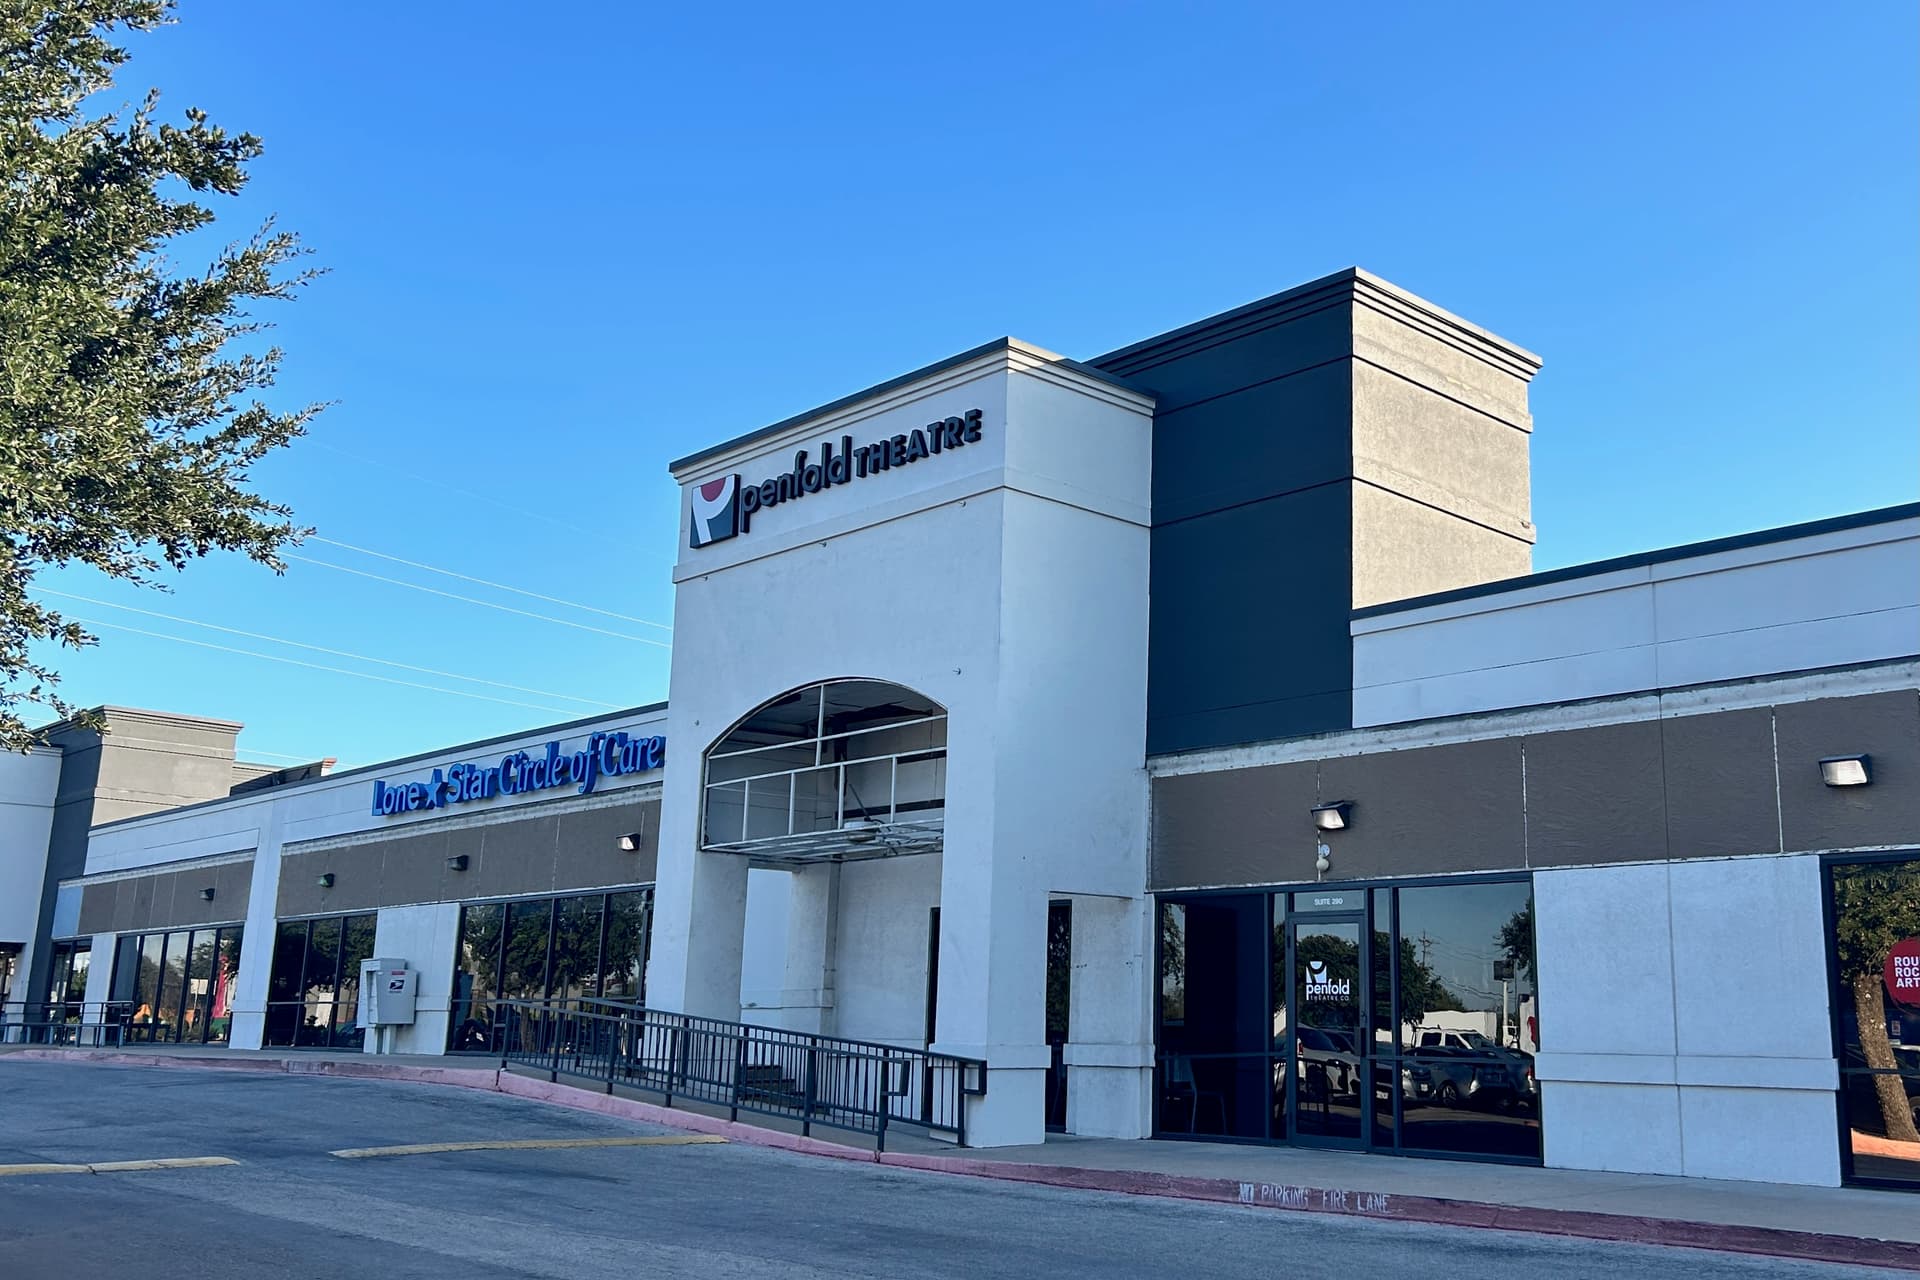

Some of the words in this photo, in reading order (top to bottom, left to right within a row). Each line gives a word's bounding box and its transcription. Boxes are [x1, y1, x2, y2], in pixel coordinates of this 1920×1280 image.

[740, 435, 852, 533] penfold
[853, 408, 982, 478] THEATRE
[371, 780, 426, 816] Lone
[446, 763, 497, 803] Star
[499, 741, 570, 795] Circle
[569, 731, 604, 794] of
[601, 732, 666, 777] Care
[1314, 898, 1331, 906] SUITE
[1306, 978, 1350, 1001] penfold
[1239, 1183, 1254, 1203] NO
[1261, 1184, 1309, 1208] PARKING
[1322, 1189, 1350, 1210] FIRE
[1357, 1191, 1391, 1214] LANE
